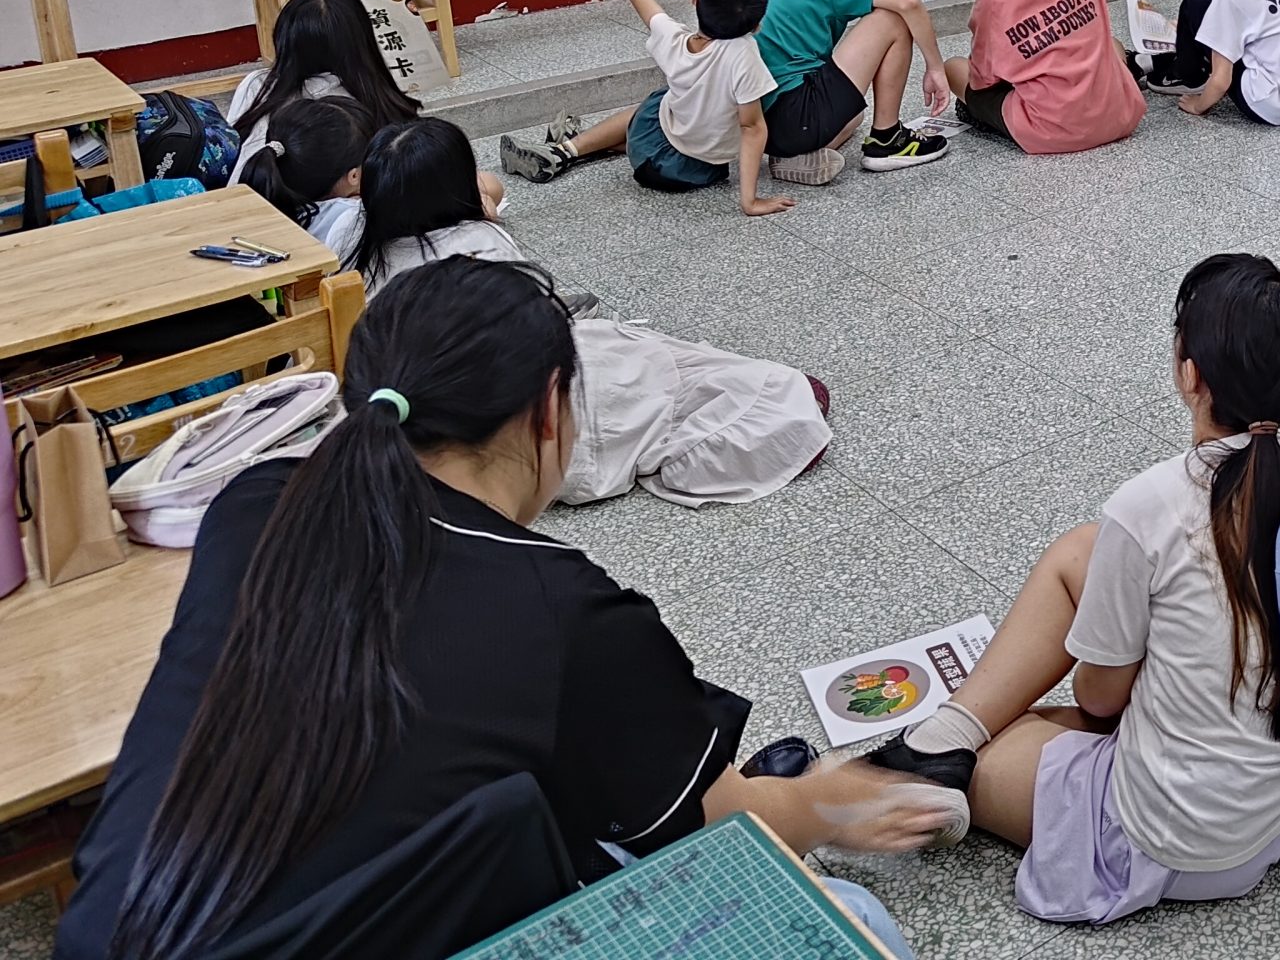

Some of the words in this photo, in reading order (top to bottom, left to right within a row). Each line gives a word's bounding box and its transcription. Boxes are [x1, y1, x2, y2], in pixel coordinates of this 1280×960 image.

[367, 8, 415, 78] 資源卡
[1005, 15, 1041, 46] HOW
[1017, 1, 1098, 60] SLAM-DUNK?
